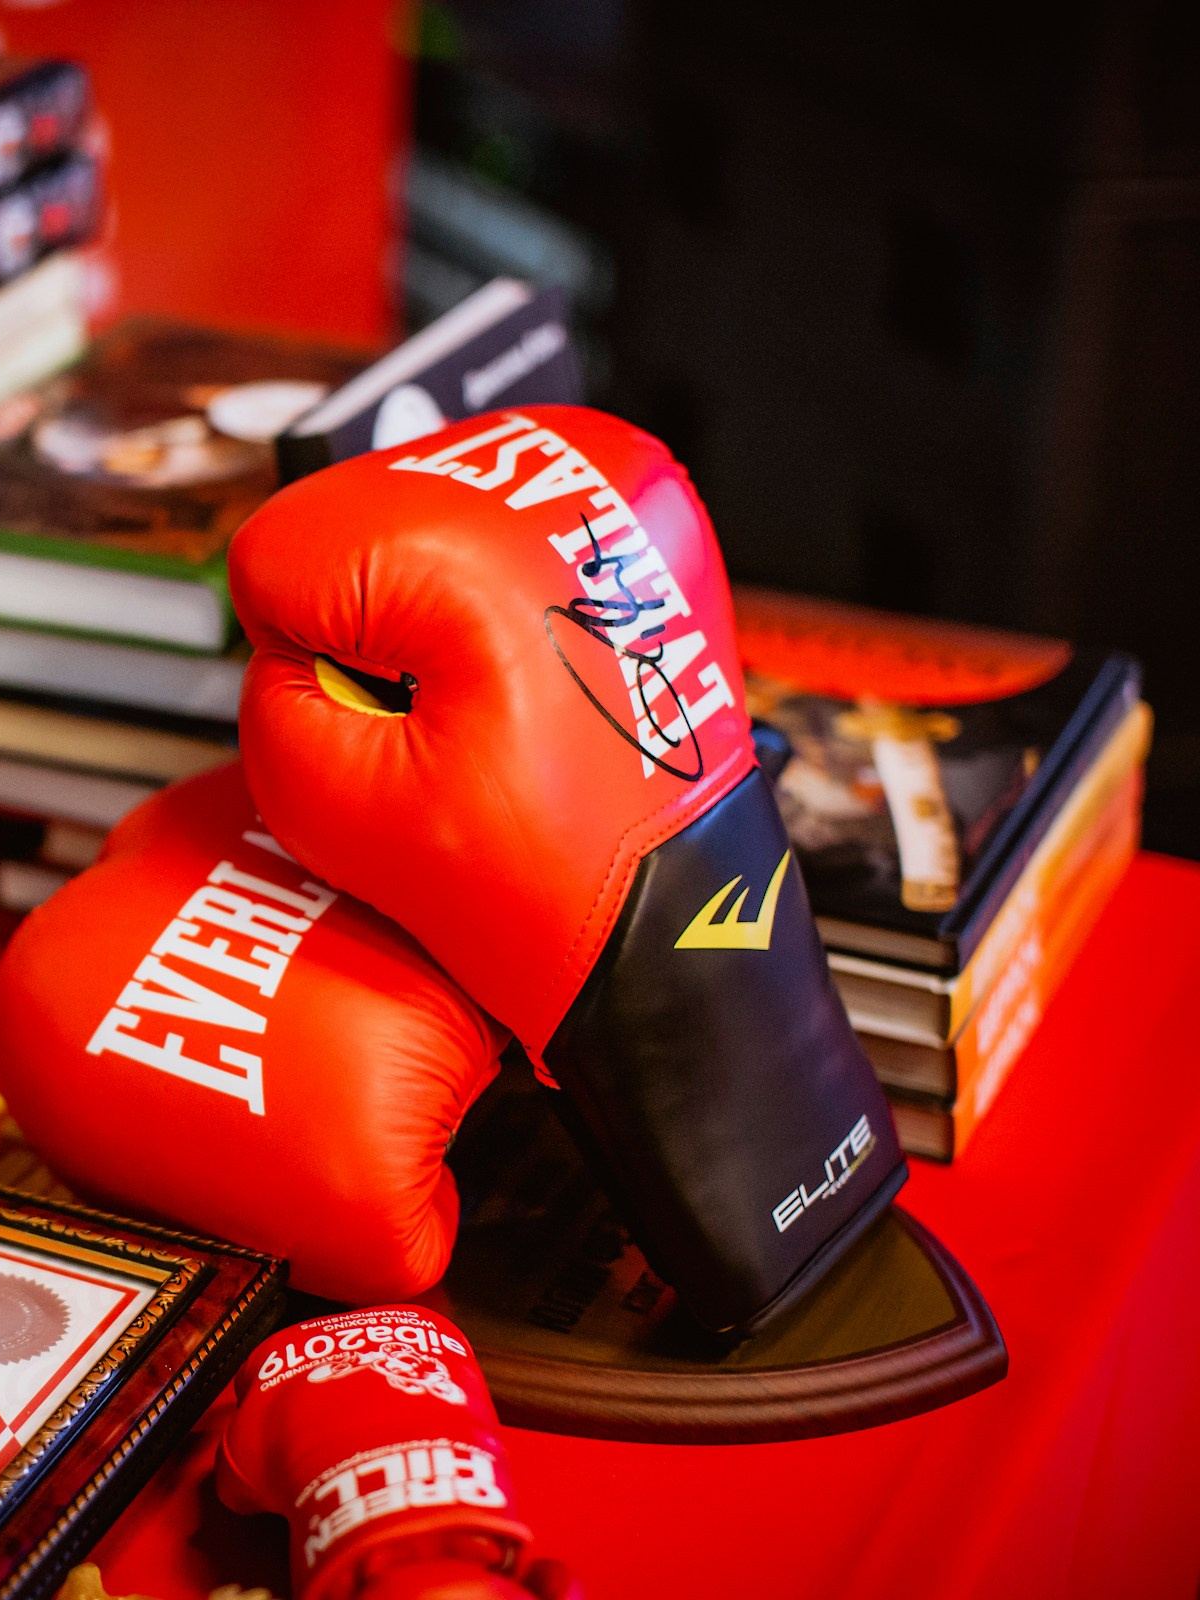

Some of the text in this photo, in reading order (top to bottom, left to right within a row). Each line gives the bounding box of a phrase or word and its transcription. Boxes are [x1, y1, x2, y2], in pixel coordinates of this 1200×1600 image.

[388, 414, 735, 779] EVERLAST
[86, 828, 338, 1116] EVERL
[772, 1114, 873, 1233] ELITE
[300, 1311, 419, 1330] CHAMPIONSHIPS
[323, 1317, 437, 1332] WORLD BOXING
